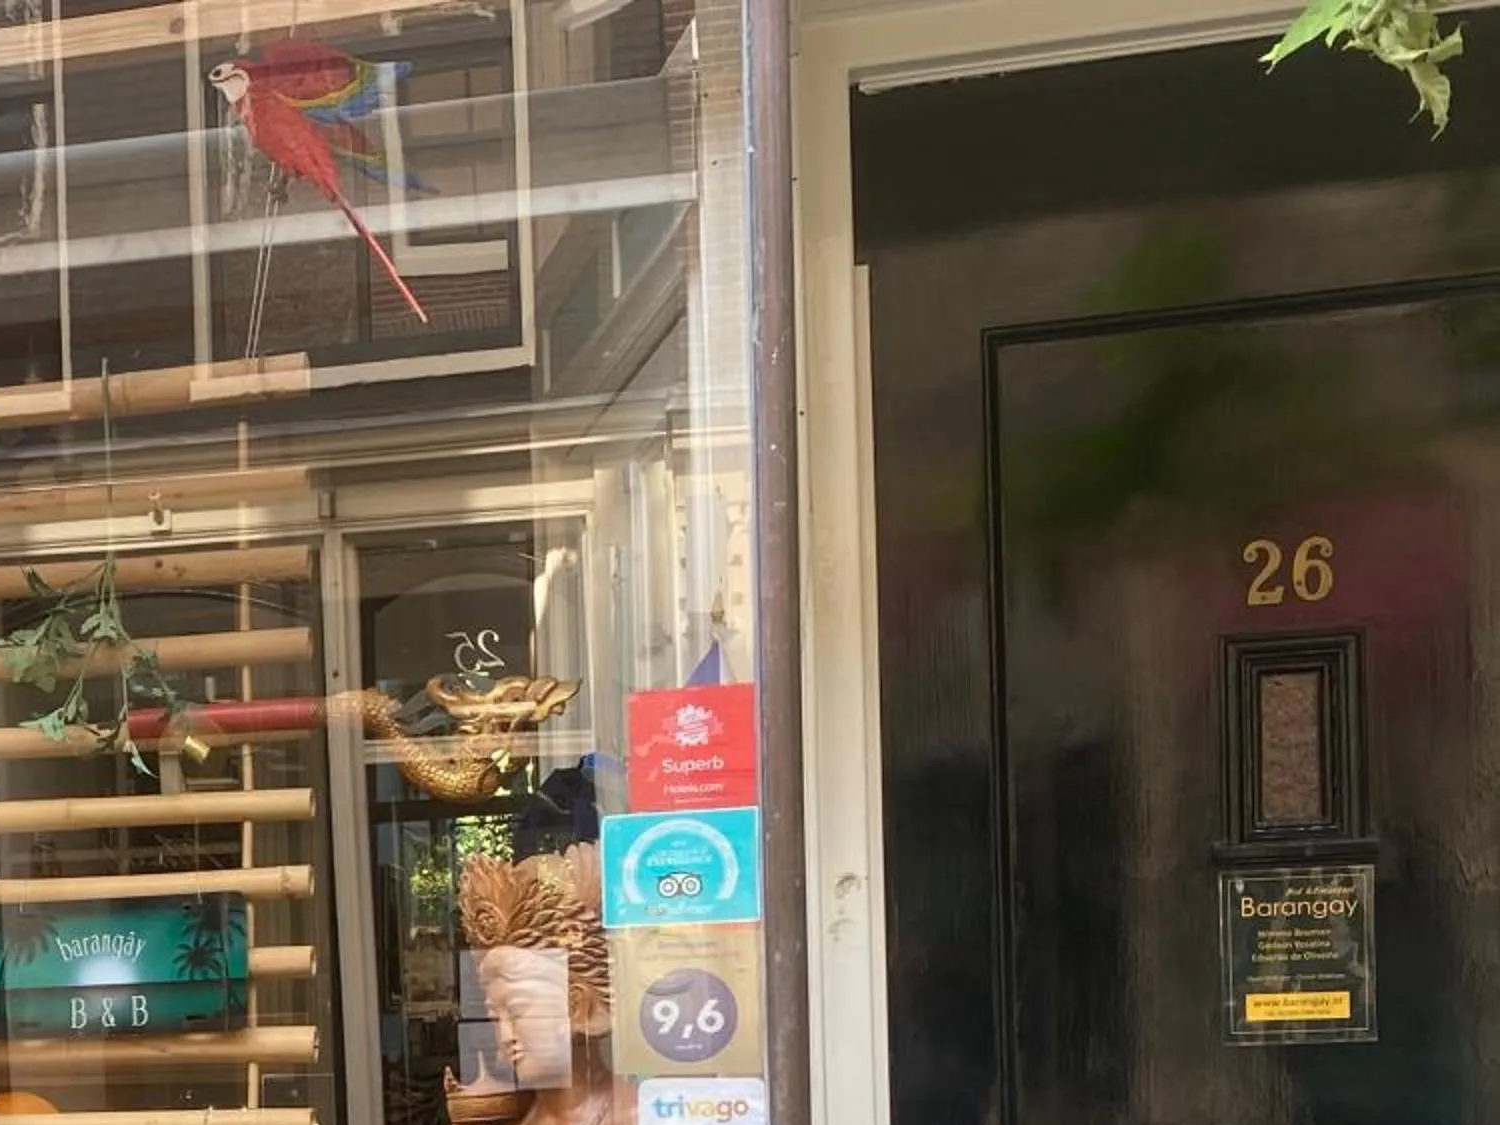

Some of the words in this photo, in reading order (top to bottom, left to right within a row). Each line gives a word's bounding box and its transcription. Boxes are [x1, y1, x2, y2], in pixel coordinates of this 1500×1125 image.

[1243, 535, 1333, 606] 26
[662, 755, 725, 776] Superb
[1240, 896, 1358, 919] Barangay
[56, 931, 147, 962] barangay
[70, 997, 88, 1029] B
[101, 998, 117, 1028] &
[131, 995, 149, 1028] B
[652, 998, 726, 1040] 9,6
[652, 1094, 749, 1123] trivago
